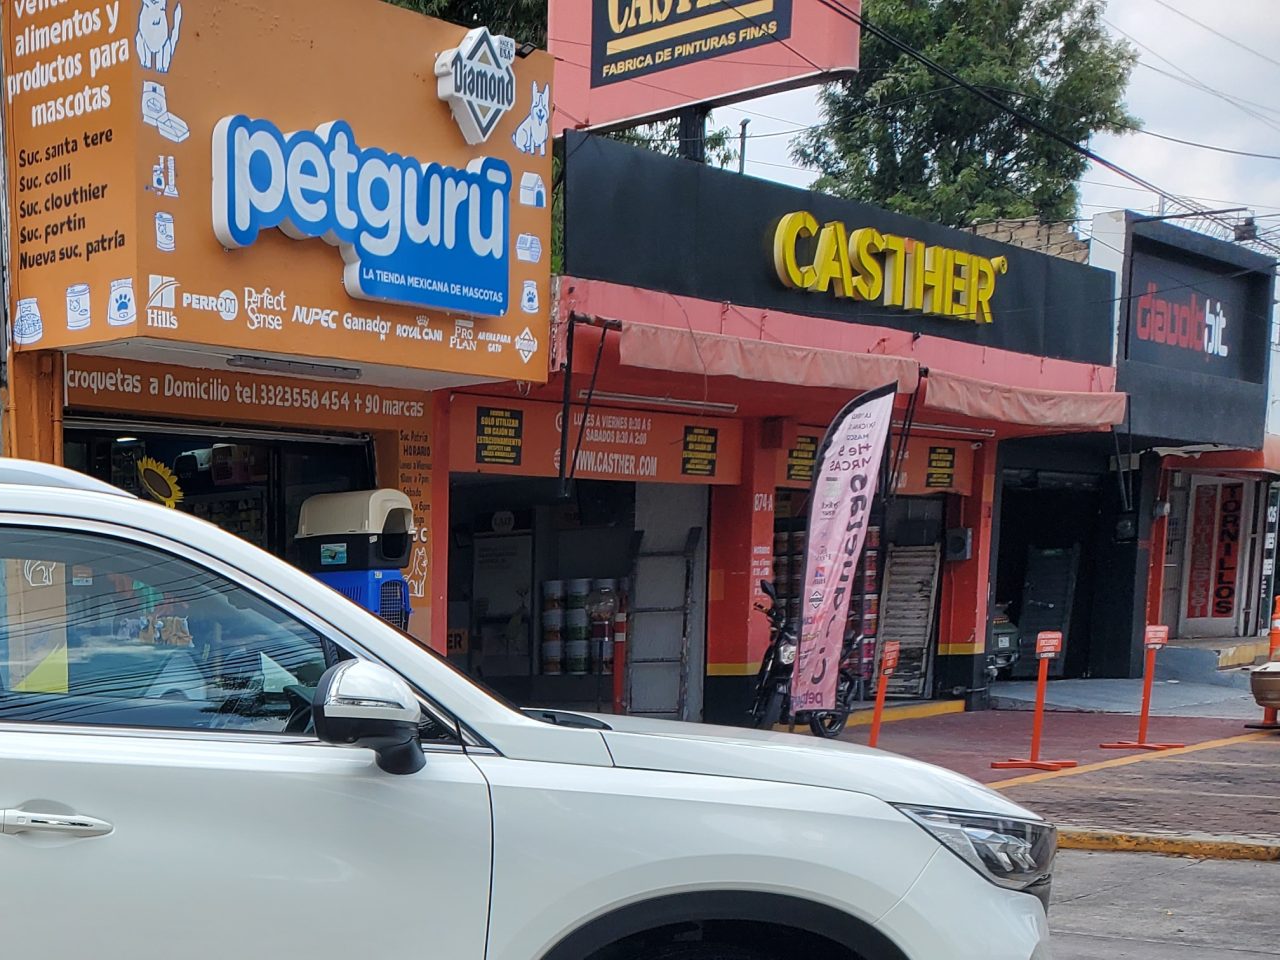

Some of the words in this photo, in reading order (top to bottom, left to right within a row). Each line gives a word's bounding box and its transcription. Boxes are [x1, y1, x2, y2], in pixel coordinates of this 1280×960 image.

[16, 7, 101, 57] alimentos
[106, 1, 119, 33] y
[602, 55, 653, 77] FABRICA
[655, 52, 673, 64] DE
[674, 31, 737, 58] PINTURAS
[739, 21, 778, 43] FINAS
[7, 52, 82, 104] productos
[90, 37, 130, 78] para
[451, 51, 514, 107] Diamond
[31, 84, 111, 127] mascotas
[19, 149, 43, 168] Suc.
[45, 137, 78, 161] santa
[83, 128, 113, 148] tere
[19, 176, 42, 193] Suc.
[19, 200, 42, 219] Suc.
[44, 182, 108, 212] clouthier
[19, 226, 42, 245] Suc.
[19, 249, 56, 270] Nueva
[59, 243, 82, 261] suc.
[773, 210, 993, 324] CASTHER
[363, 267, 375, 281] LA
[376, 269, 406, 286] TIENDA
[407, 275, 449, 294] MEXICANA
[451, 283, 461, 296] DE
[462, 286, 503, 304] MASCOTAS
[182, 292, 236, 314] PERRON
[244, 286, 287, 312] Perfect
[147, 309, 178, 330] Hill's
[246, 305, 283, 330] Sense
[291, 305, 339, 329] NUPEC
[342, 312, 392, 334] Ganador
[396, 323, 422, 340] ROYAL
[449, 337, 477, 351] PLAN
[455, 326, 474, 340] PRO
[67, 368, 142, 394] croquetas
[149, 376, 159, 395] a
[164, 373, 230, 402] Domicilio
[365, 393, 380, 414] 90
[382, 398, 424, 417] marcas
[403, 445, 431, 457] HORARIO
